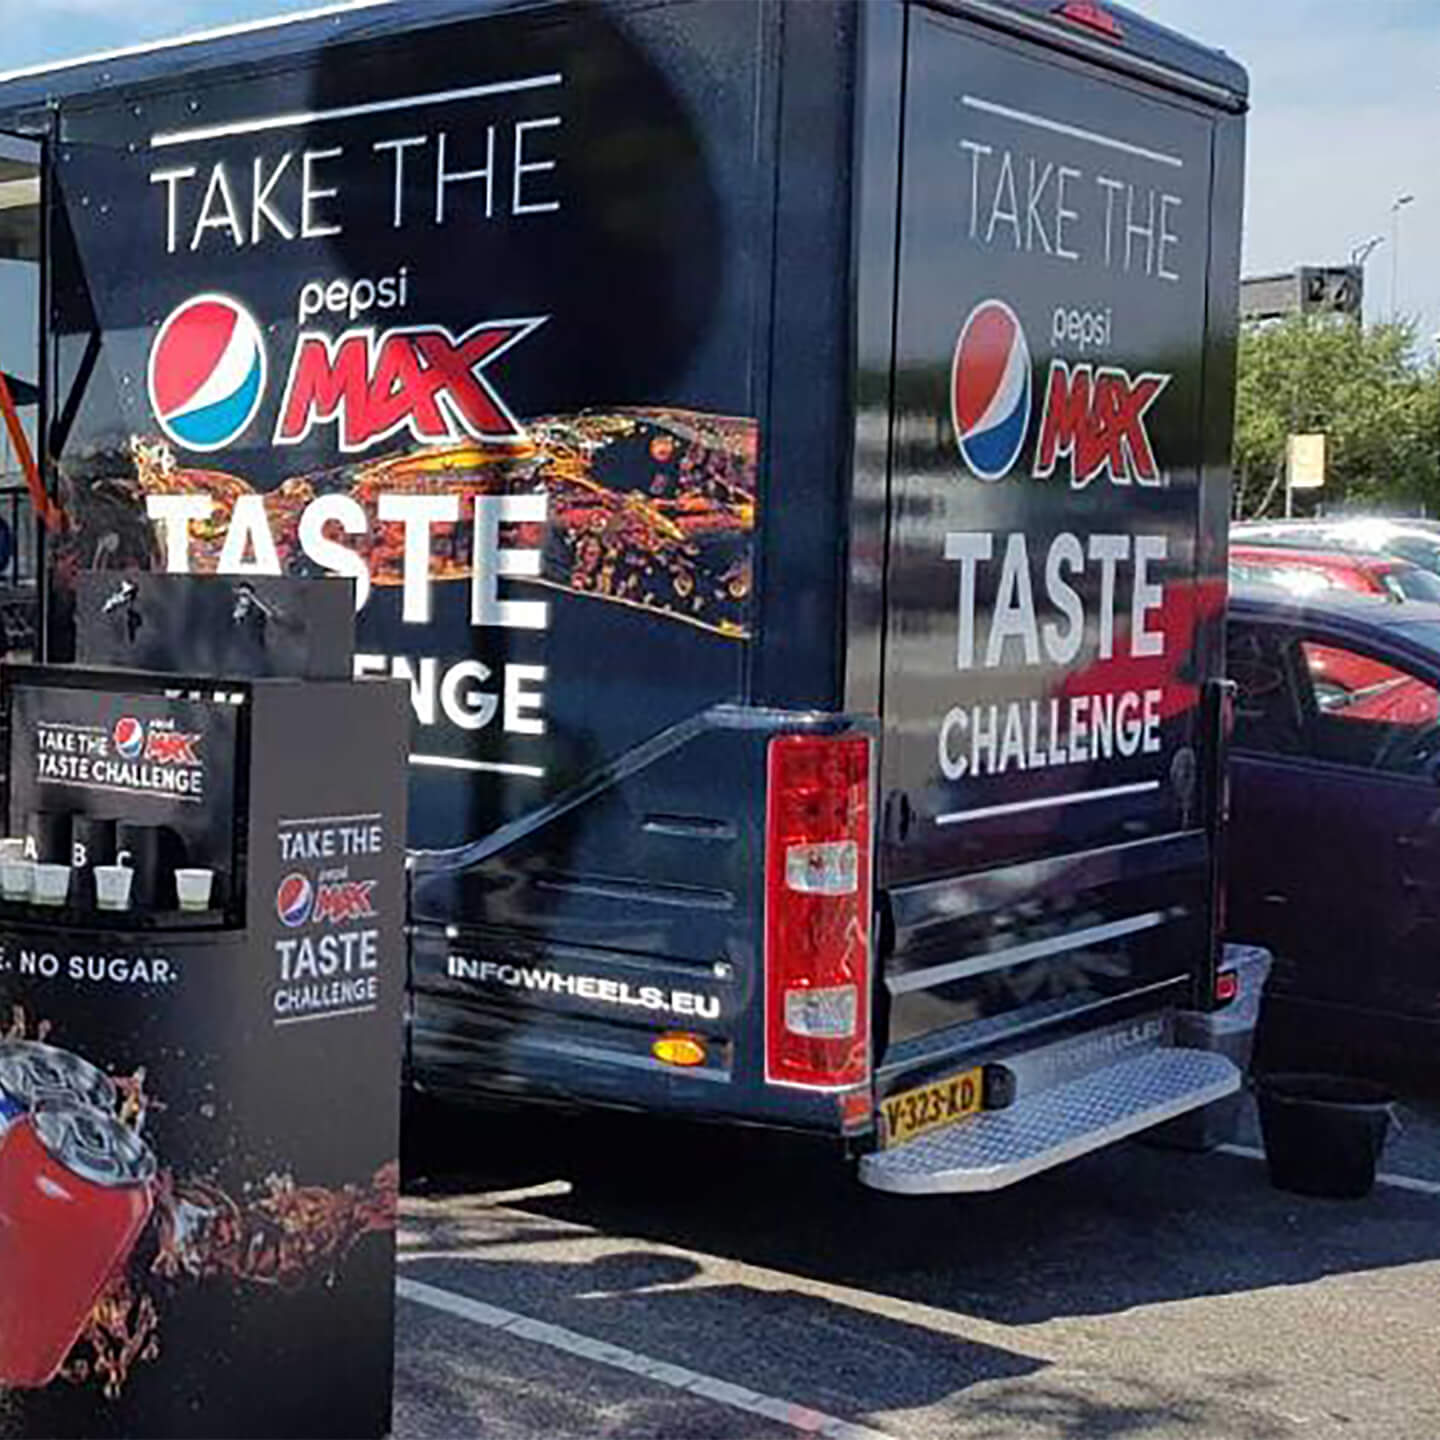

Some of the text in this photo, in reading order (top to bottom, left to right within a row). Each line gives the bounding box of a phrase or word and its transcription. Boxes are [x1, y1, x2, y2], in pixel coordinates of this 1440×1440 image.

[149, 116, 561, 253] TAKE THE
[960, 140, 1183, 281] TAKE THE
[298, 267, 407, 323] pepsi
[1051, 306, 1111, 348] pepsi
[272, 315, 553, 452] MAX
[1031, 359, 1173, 490] MAX
[146, 493, 549, 630] TASTE
[944, 532, 1167, 670] TASTE
[37, 730, 76, 753] TAKE
[77, 734, 109, 756] THE
[937, 689, 1163, 780] CHALLENGE
[37, 753, 203, 793] TASTE CHALLENGE
[24, 835, 38, 859] A
[72, 842, 87, 868] B
[278, 826, 383, 861] TAKE THE
[20, 950, 60, 977] NO
[68, 955, 178, 983] SUGAR.
[275, 930, 379, 981] TASTE
[274, 976, 379, 1013] CHALLENGE
[447, 955, 721, 1019] INFOWHEELS.EU
